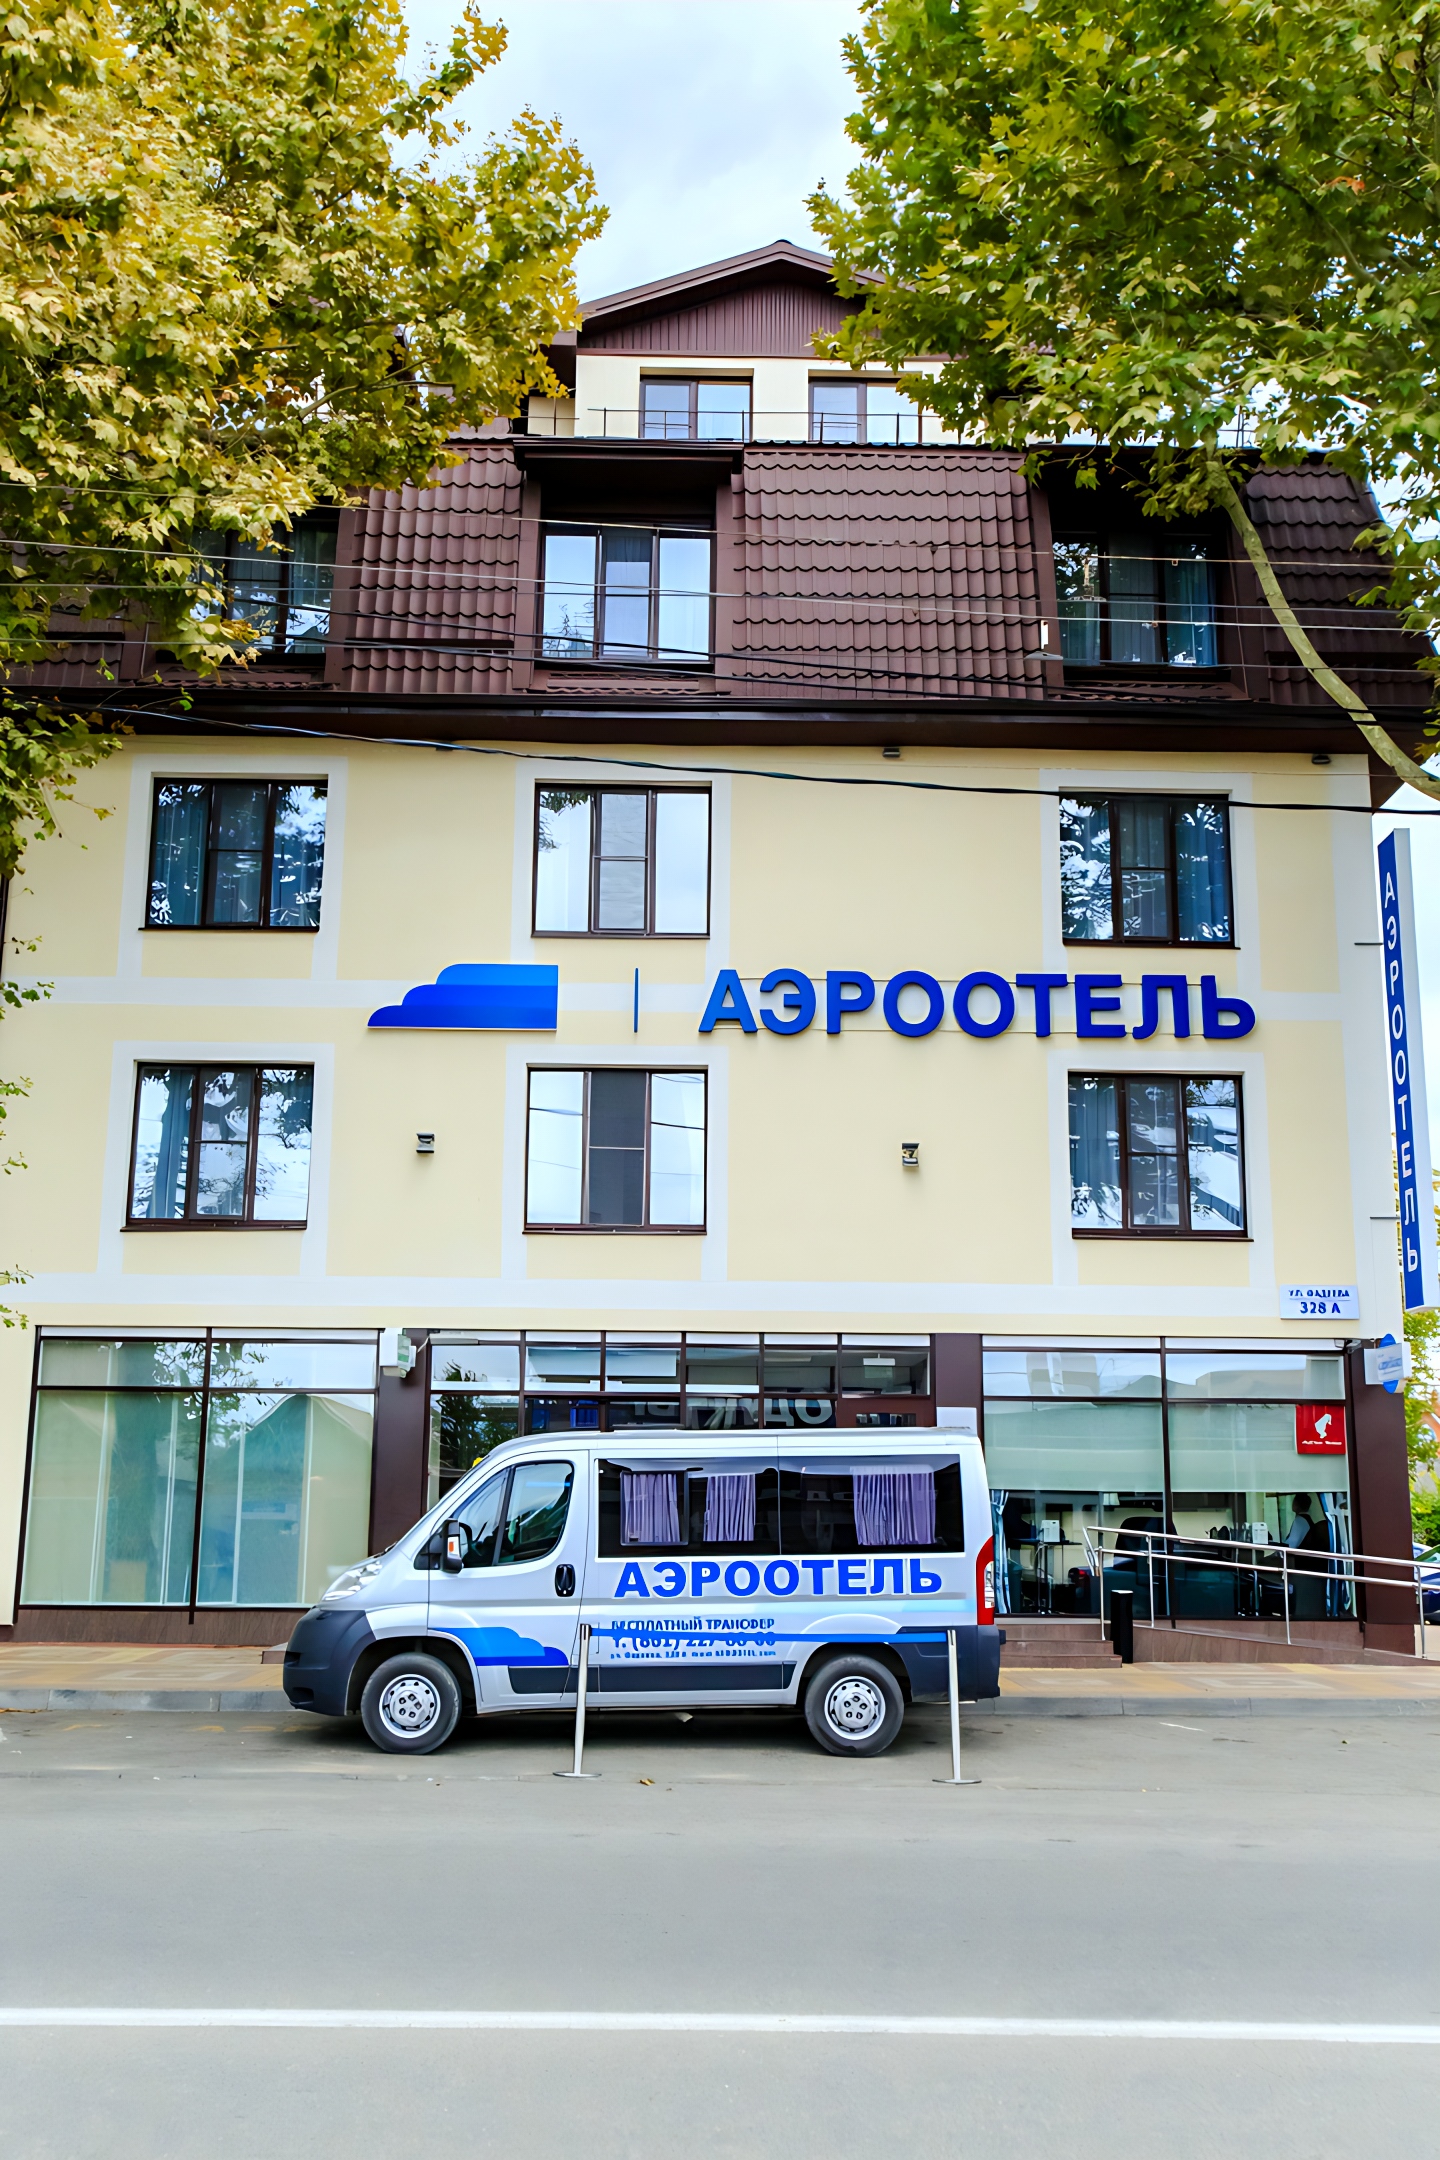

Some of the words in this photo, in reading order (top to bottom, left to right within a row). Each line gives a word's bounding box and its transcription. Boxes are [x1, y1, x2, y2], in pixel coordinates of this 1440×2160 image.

[698, 967, 1256, 1040] АЭРООТЕЛЬ
[1385, 871, 1418, 1273] АЭРООТЕЛЬ
[1300, 1301, 1327, 1314] 328
[614, 1558, 943, 1598] АЭРООТЕЛЬ
